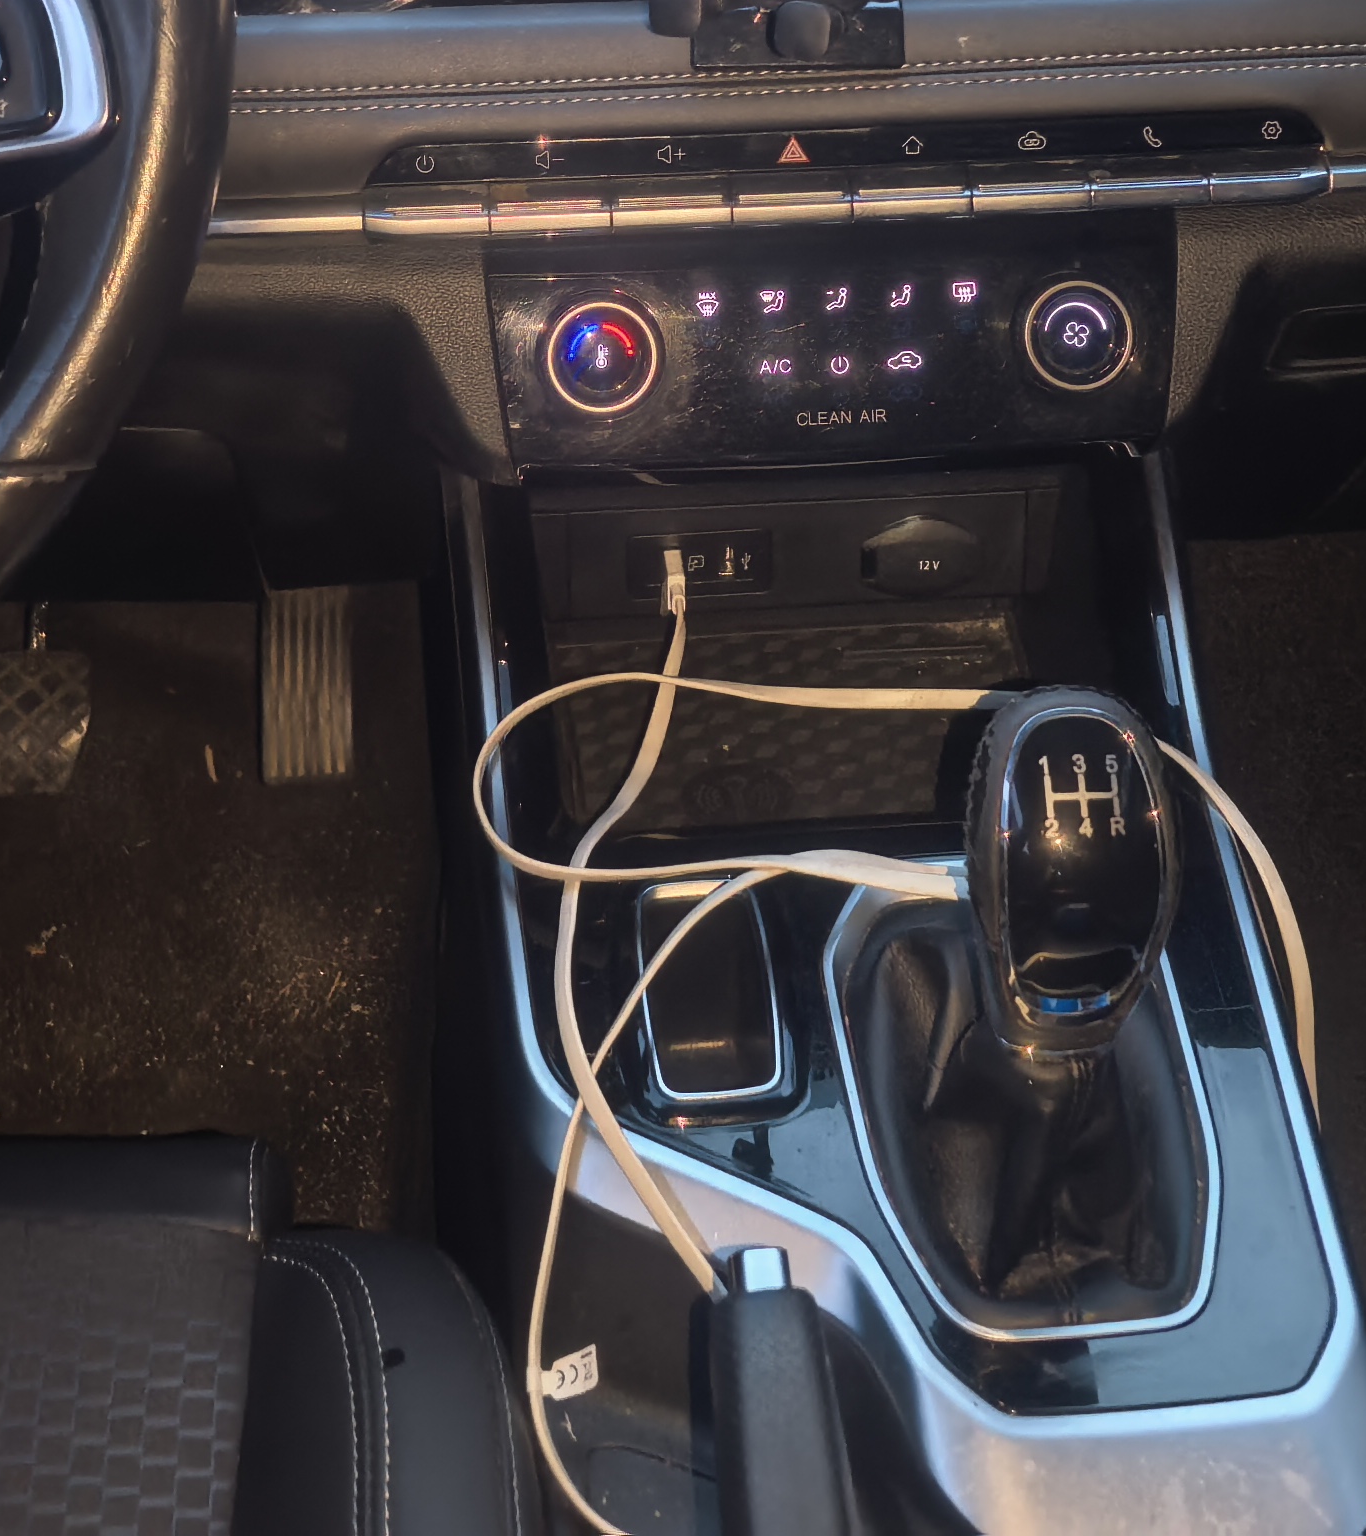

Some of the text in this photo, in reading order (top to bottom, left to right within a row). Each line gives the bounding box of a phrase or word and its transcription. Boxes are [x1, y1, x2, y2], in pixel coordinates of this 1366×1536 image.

[698, 292, 716, 300] MAX
[759, 359, 792, 374] A/C
[796, 409, 887, 426] CLEAN AIR
[919, 560, 940, 571] 12 V
[1038, 753, 1118, 775] 1 3 5
[1045, 816, 1126, 839] 2 4 R
